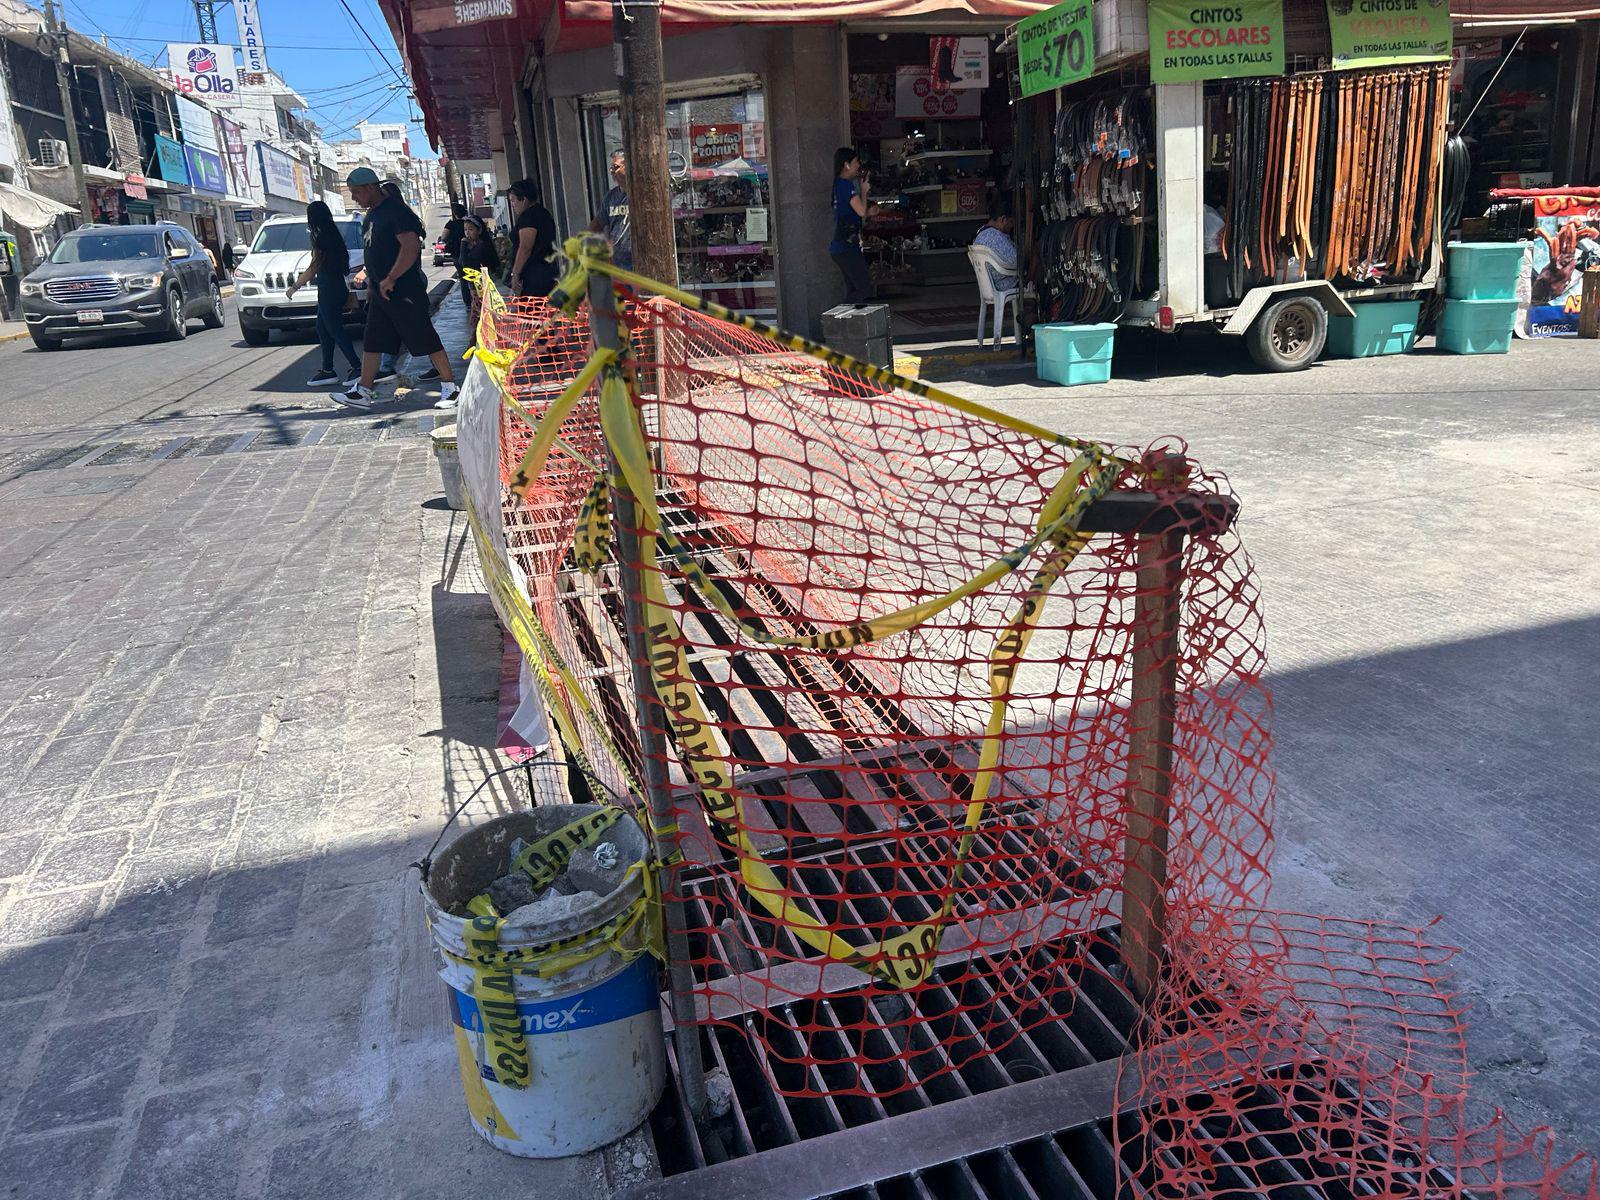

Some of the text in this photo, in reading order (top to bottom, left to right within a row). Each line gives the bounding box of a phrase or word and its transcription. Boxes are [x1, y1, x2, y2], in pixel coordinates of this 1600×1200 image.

[1190, 7, 1243, 24] CINTOS
[1360, 0, 1401, 13] CINTOS
[1405, 0, 1418, 10] DE
[240, 0, 261, 71] ILARES
[1022, 5, 1088, 43] CINTOS DE VESTIR
[1165, 25, 1271, 49] ESCOLARES
[1354, 45, 1363, 53] EN
[1365, 43, 1387, 52] TODAS
[1388, 42, 1402, 50] LAS
[1403, 40, 1427, 49] TALLAS
[1023, 29, 1085, 77] DESDE $70
[1164, 52, 1272, 68] EN TODAS LAS TALLAS
[520, 998, 585, 1032] mex
